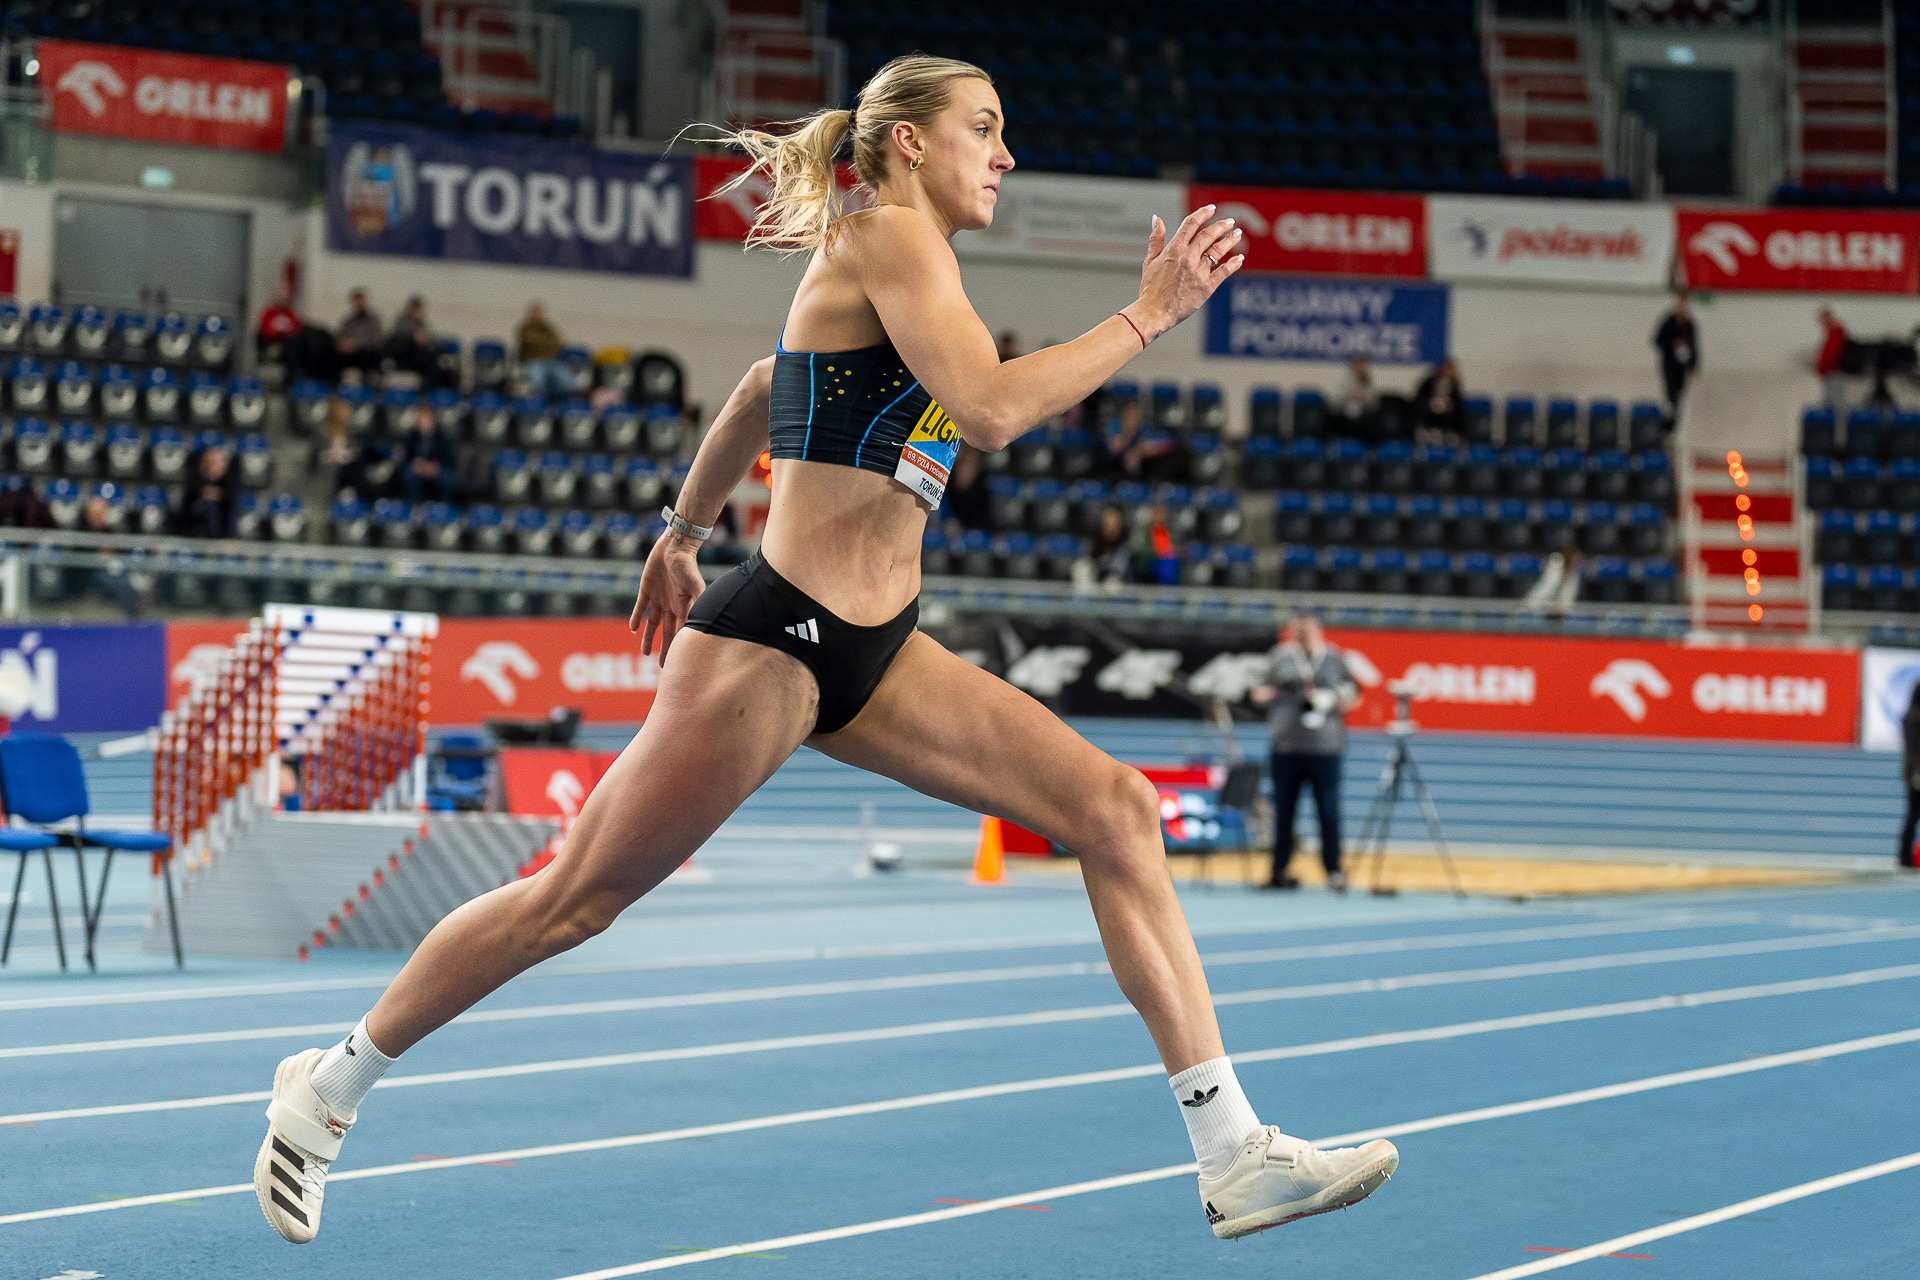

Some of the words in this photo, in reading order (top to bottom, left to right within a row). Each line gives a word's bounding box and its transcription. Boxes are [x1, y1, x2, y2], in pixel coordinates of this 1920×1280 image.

[134, 74, 271, 127] ORLEN
[418, 161, 683, 246] TORUŃ
[1274, 210, 1413, 255] ORLEN
[1764, 229, 1904, 272] ORLEN
[1228, 319, 1421, 360] POMORZE
[561, 652, 661, 692] ORLE
[1403, 662, 1537, 705] ORLEN
[1692, 673, 1828, 715] ORLEN
